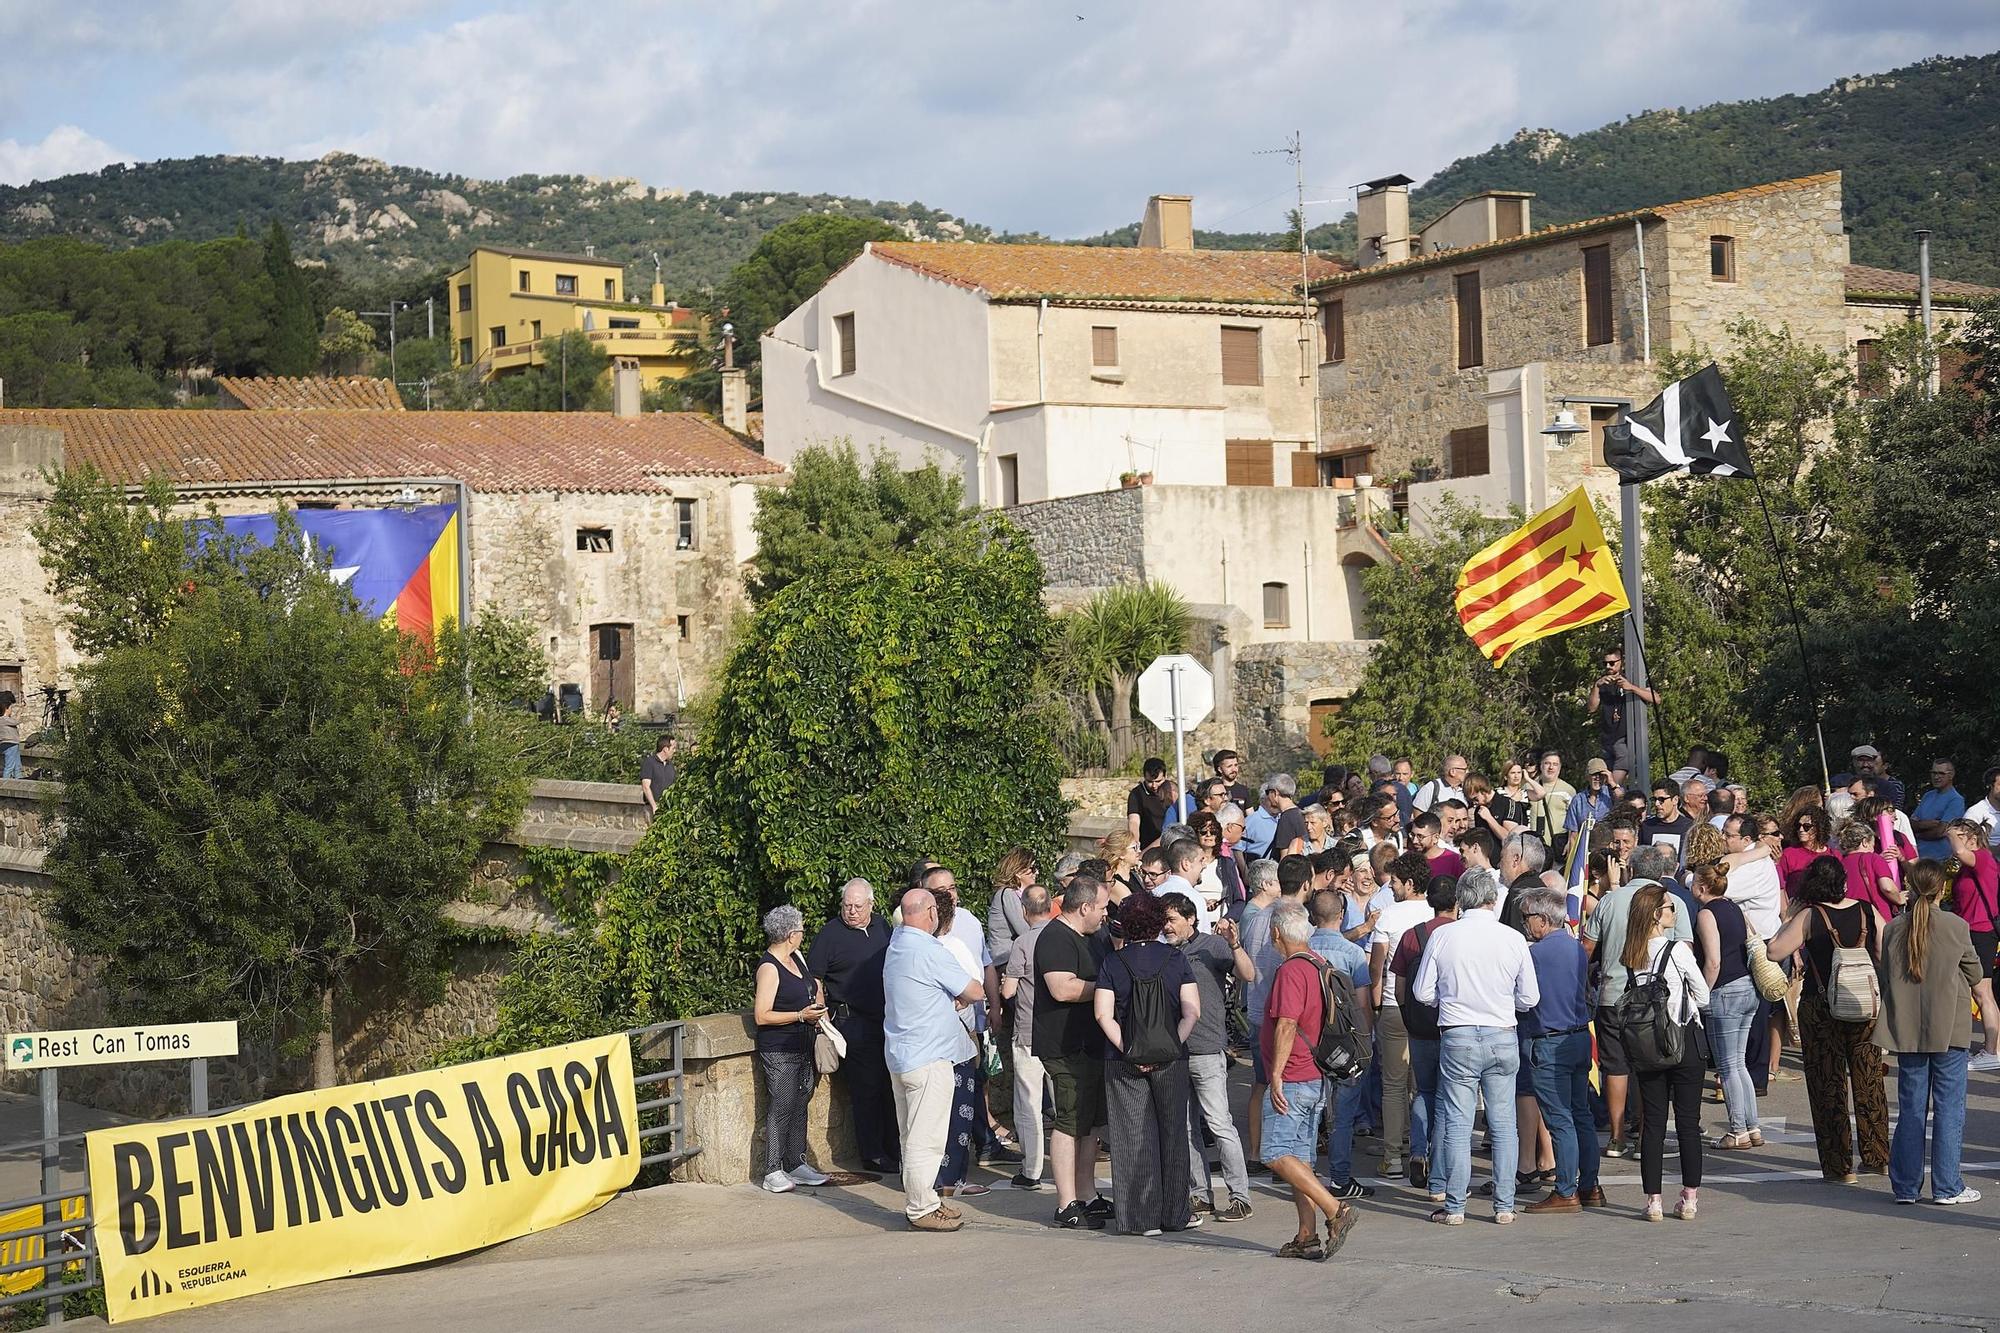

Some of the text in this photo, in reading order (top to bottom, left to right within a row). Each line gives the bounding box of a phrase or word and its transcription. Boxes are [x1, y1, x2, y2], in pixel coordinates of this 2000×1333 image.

[39, 1031, 190, 1058] Rest Can Tomas
[113, 1055, 629, 1256] BENVINGUTS A CASA
[178, 1260, 231, 1278] ESQUERRA
[180, 1269, 247, 1290] REPUBLICANA
